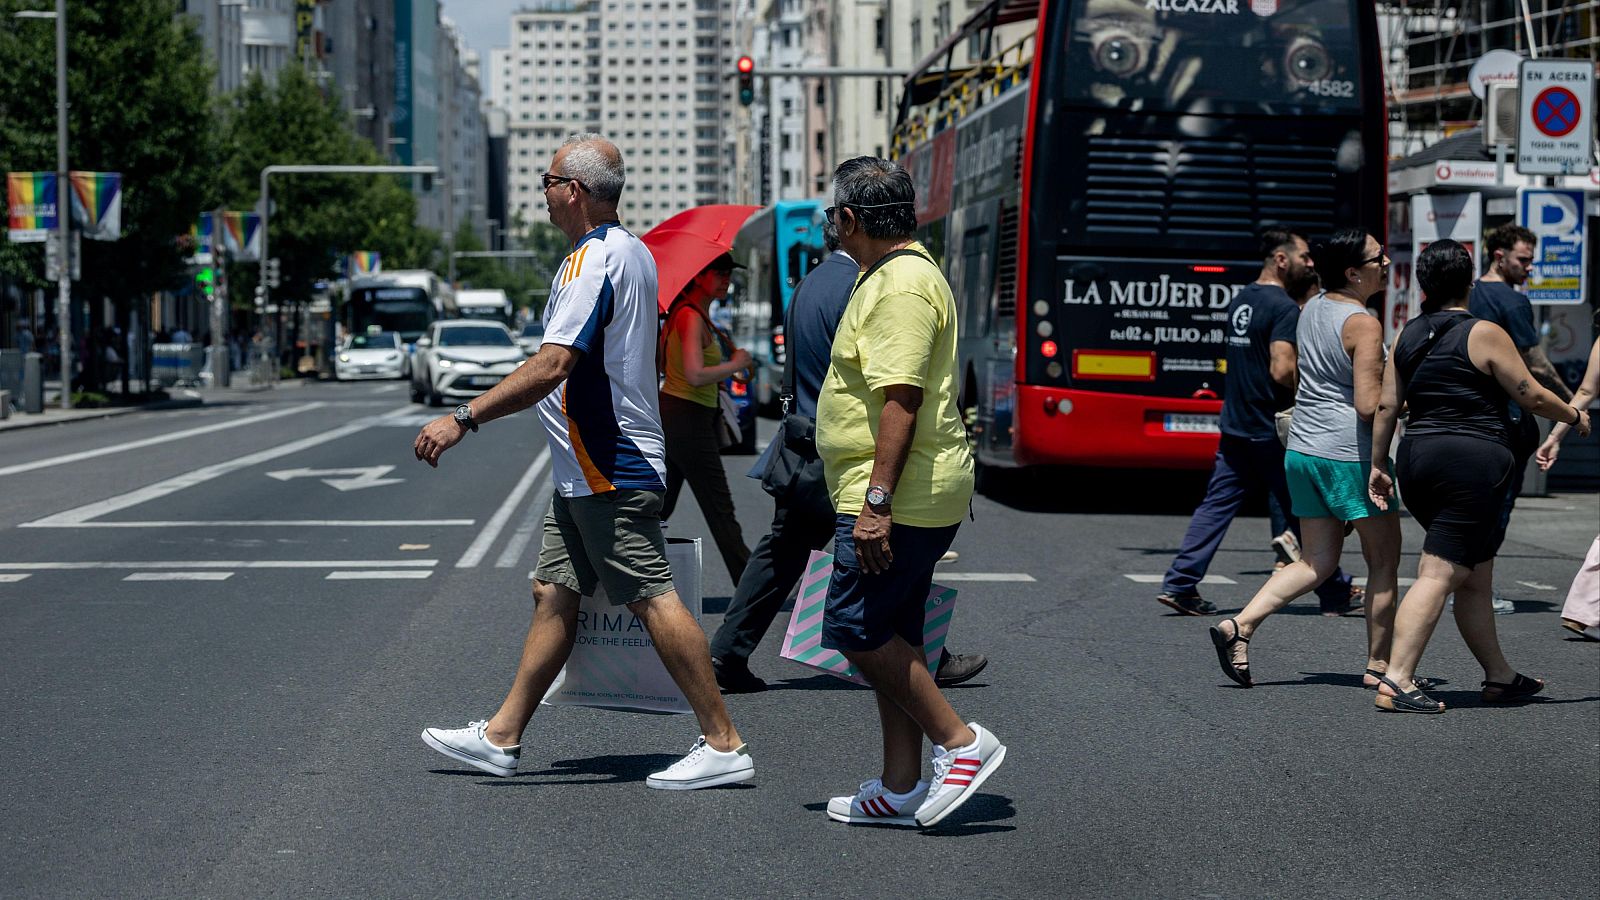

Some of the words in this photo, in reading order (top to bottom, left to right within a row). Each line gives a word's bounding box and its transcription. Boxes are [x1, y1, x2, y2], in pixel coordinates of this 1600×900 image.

[1527, 71, 1542, 81] EN
[1549, 72, 1587, 81] ACERA
[1308, 80, 1354, 97] 4582
[1530, 141, 1554, 149] TODO
[1064, 279, 1103, 305] LA
[1109, 274, 1204, 309] MUJER
[1126, 325, 1141, 341] 02
[1153, 326, 1201, 345] JULIO
[577, 610, 644, 633] RIMA
[601, 637, 620, 646] THE
[622, 638, 655, 647] FEELIN
